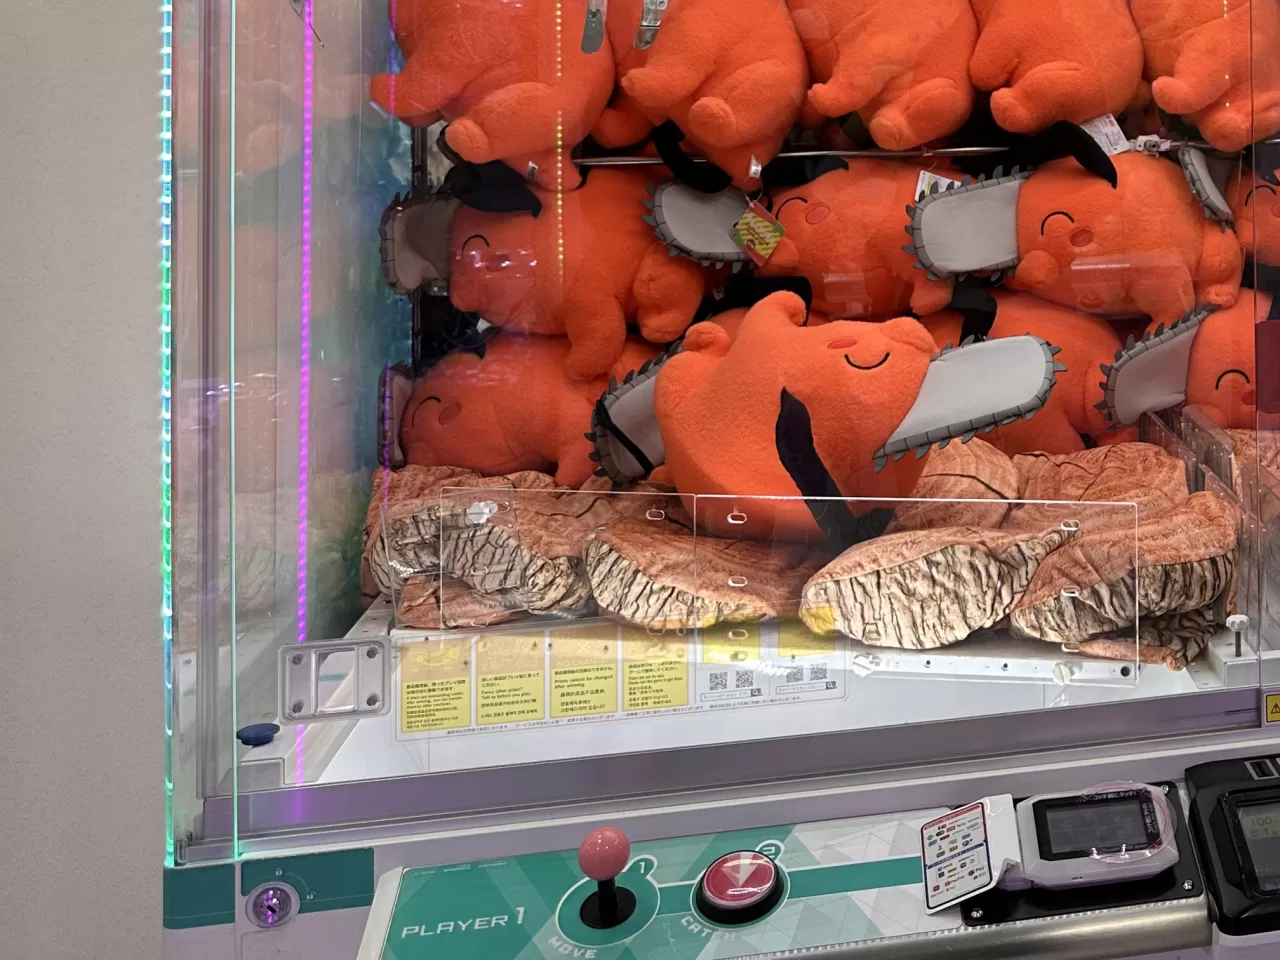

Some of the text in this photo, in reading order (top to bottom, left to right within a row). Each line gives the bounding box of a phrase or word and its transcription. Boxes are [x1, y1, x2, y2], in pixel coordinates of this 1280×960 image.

[401, 906, 525, 939] PLAYER 1
[680, 915, 736, 941] CATCH
[547, 935, 598, 960] MOVE
